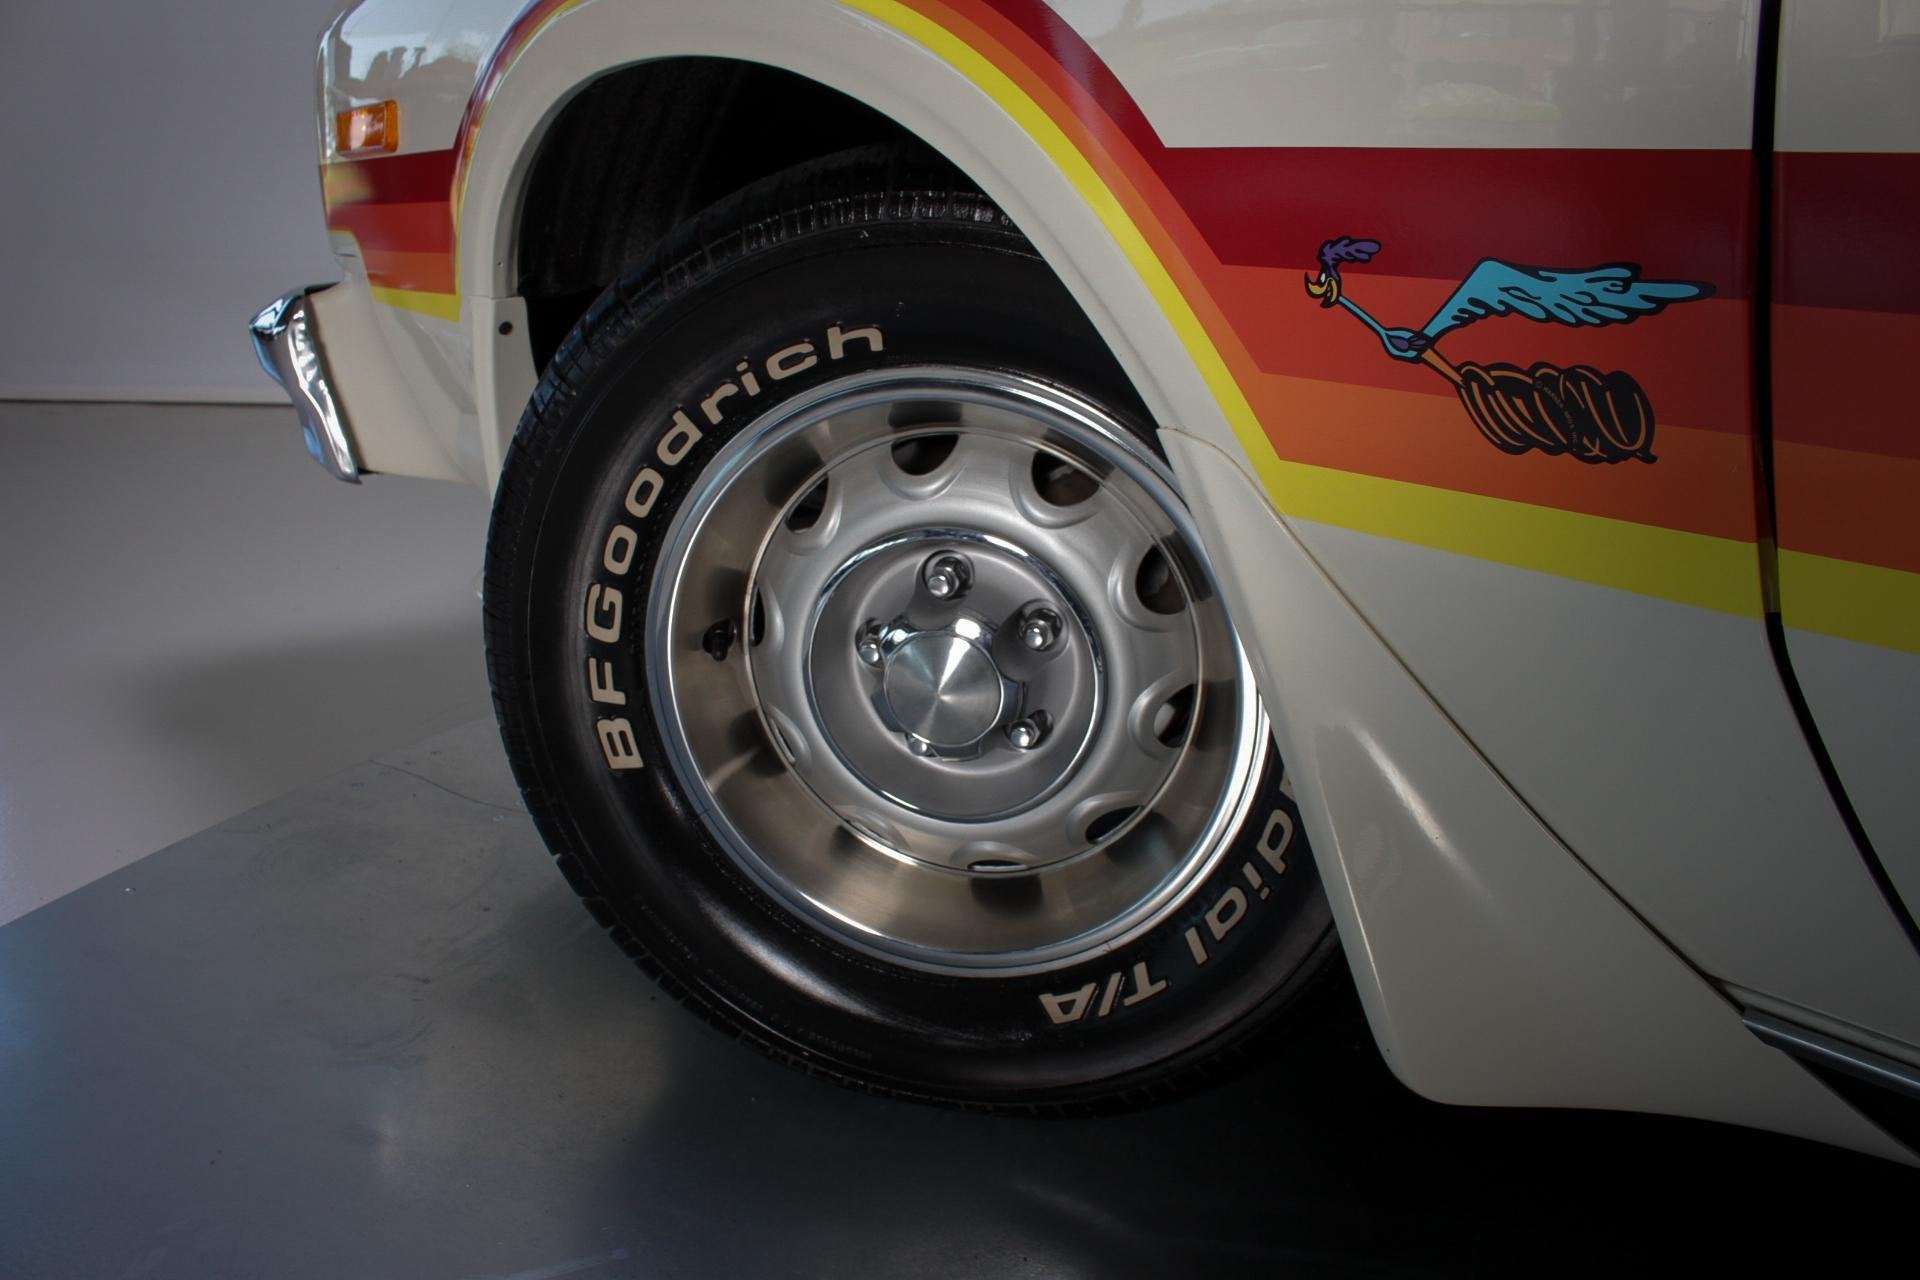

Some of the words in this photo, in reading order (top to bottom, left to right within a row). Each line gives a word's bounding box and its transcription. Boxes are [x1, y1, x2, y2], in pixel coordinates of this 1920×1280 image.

[586, 324, 885, 770] BFGoodrich
[1184, 768, 1297, 965] dial
[1039, 961, 1168, 1024] T/A
